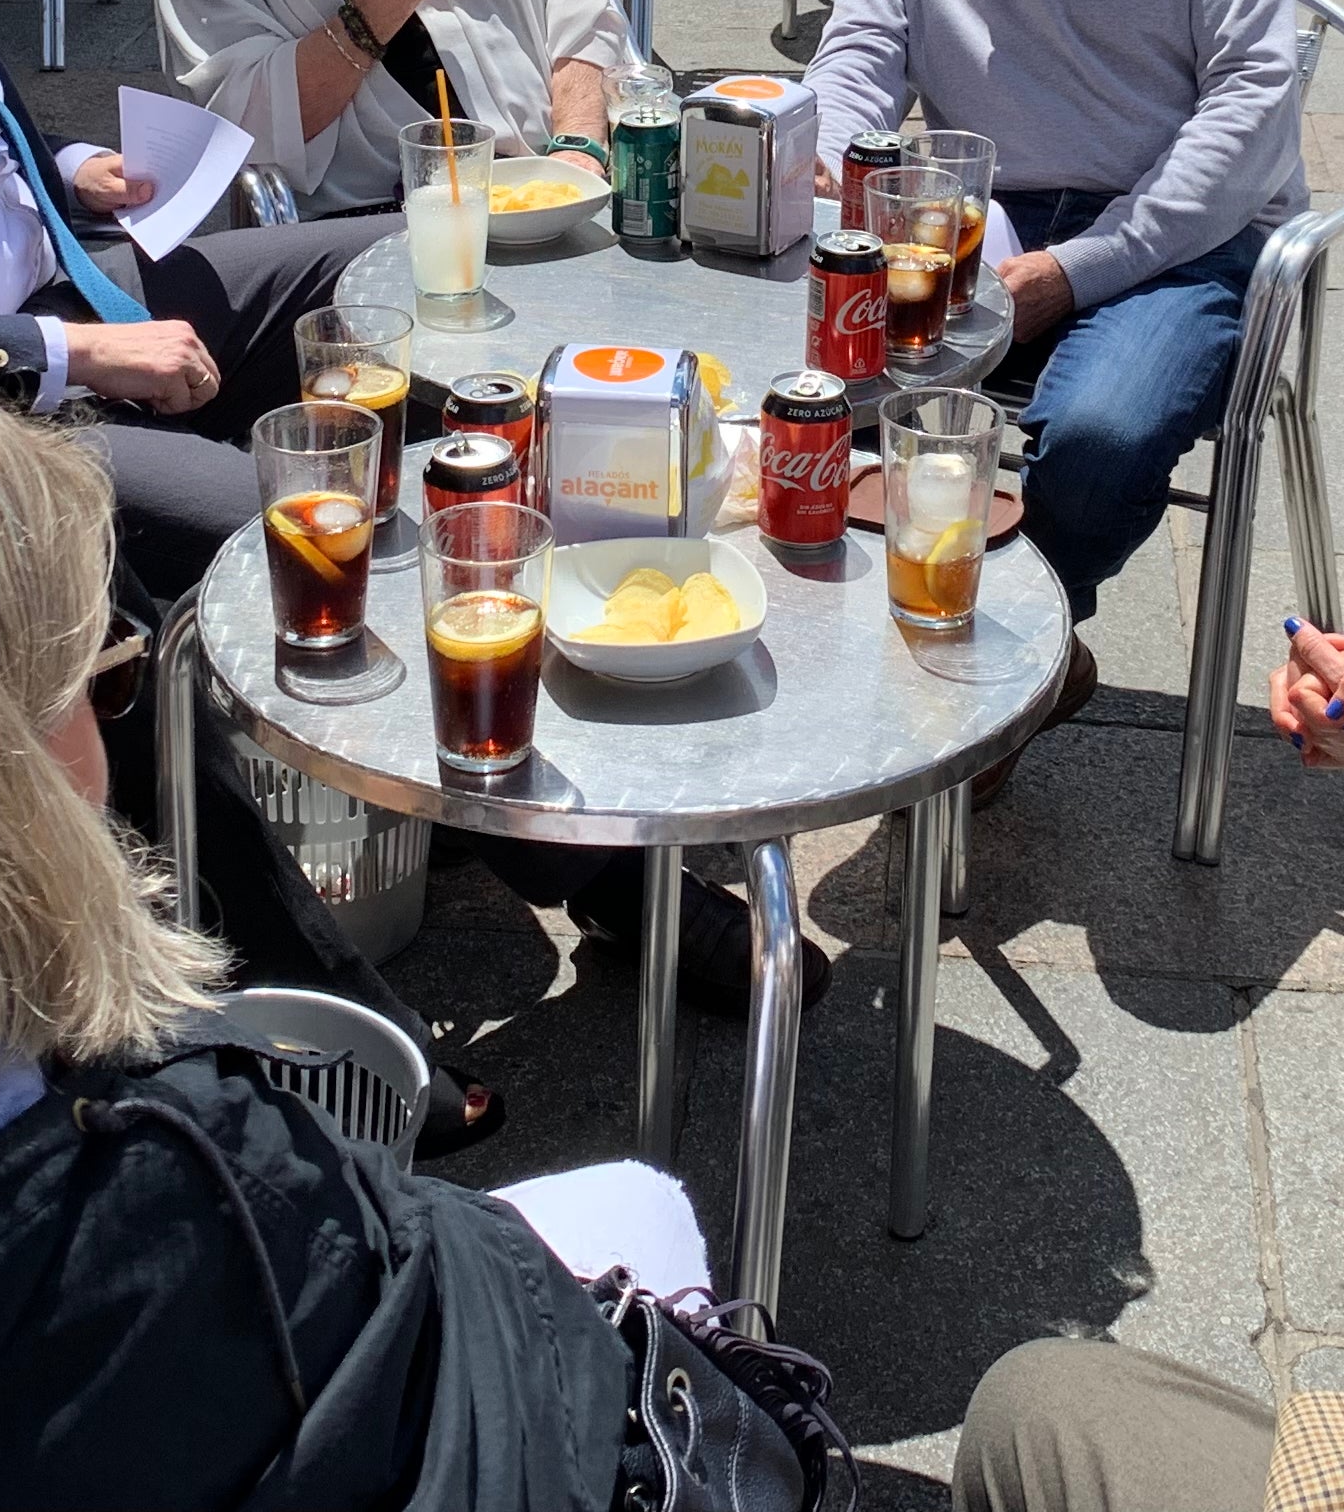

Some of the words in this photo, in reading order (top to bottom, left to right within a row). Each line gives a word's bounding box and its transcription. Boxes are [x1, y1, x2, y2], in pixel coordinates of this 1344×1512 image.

[787, 407, 811, 418] ZERO
[814, 405, 844, 418] AZÚCAR
[482, 473, 505, 486] ZERO
[560, 478, 659, 506] alaçant
